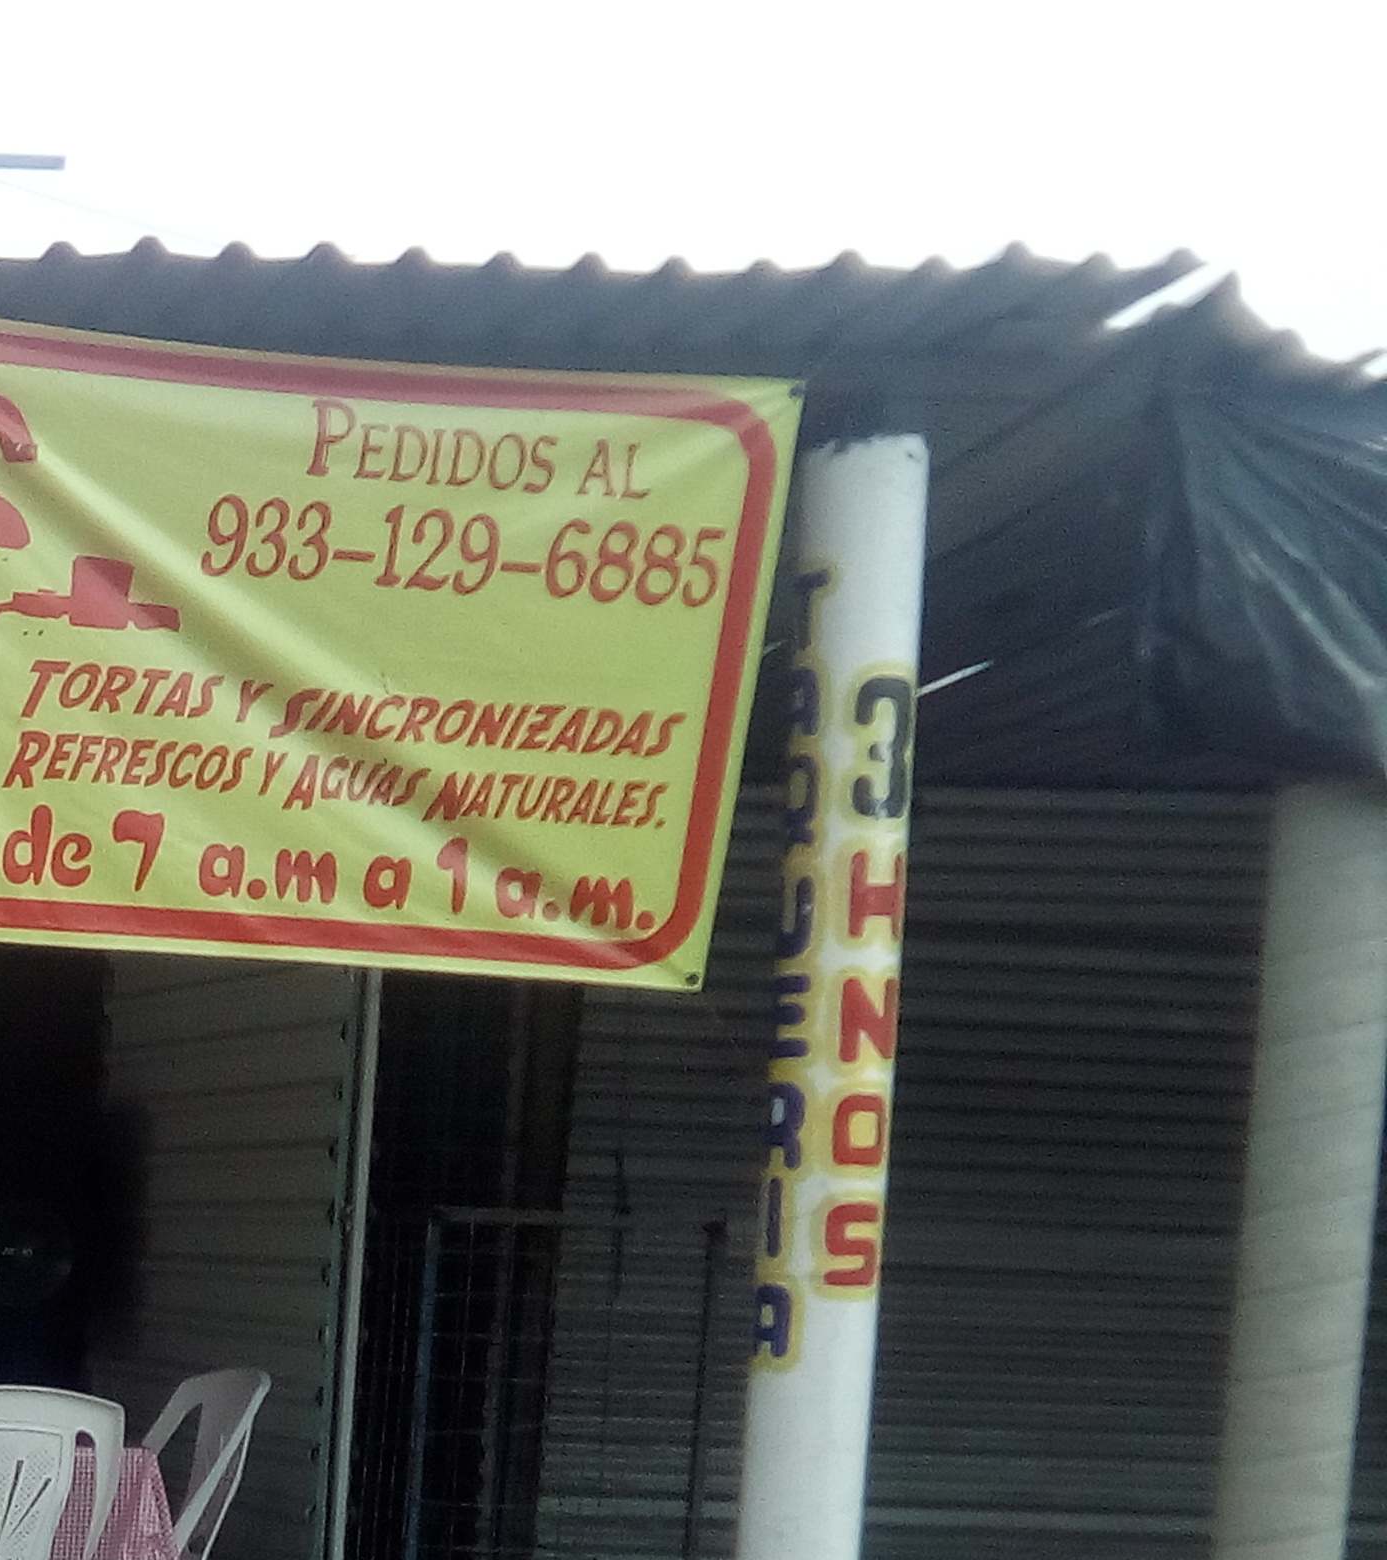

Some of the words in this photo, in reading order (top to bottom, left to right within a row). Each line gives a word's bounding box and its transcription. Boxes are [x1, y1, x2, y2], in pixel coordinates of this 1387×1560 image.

[307, 399, 558, 494] PEDIDOS
[578, 439, 649, 499] AL
[201, 495, 726, 607] 933-129-6885
[21, 660, 223, 718] TORTAS
[236, 680, 274, 722] Y
[270, 688, 685, 756] SINCRONIZADAS
[2, 731, 252, 792] REFRESCOS
[259, 752, 287, 795] Y
[283, 755, 430, 810] AGUAS
[423, 772, 668, 828] NATURALES.
[3, 805, 92, 886] de
[112, 810, 164, 890] 7
[363, 855, 412, 909] a
[437, 837, 469, 913] 1
